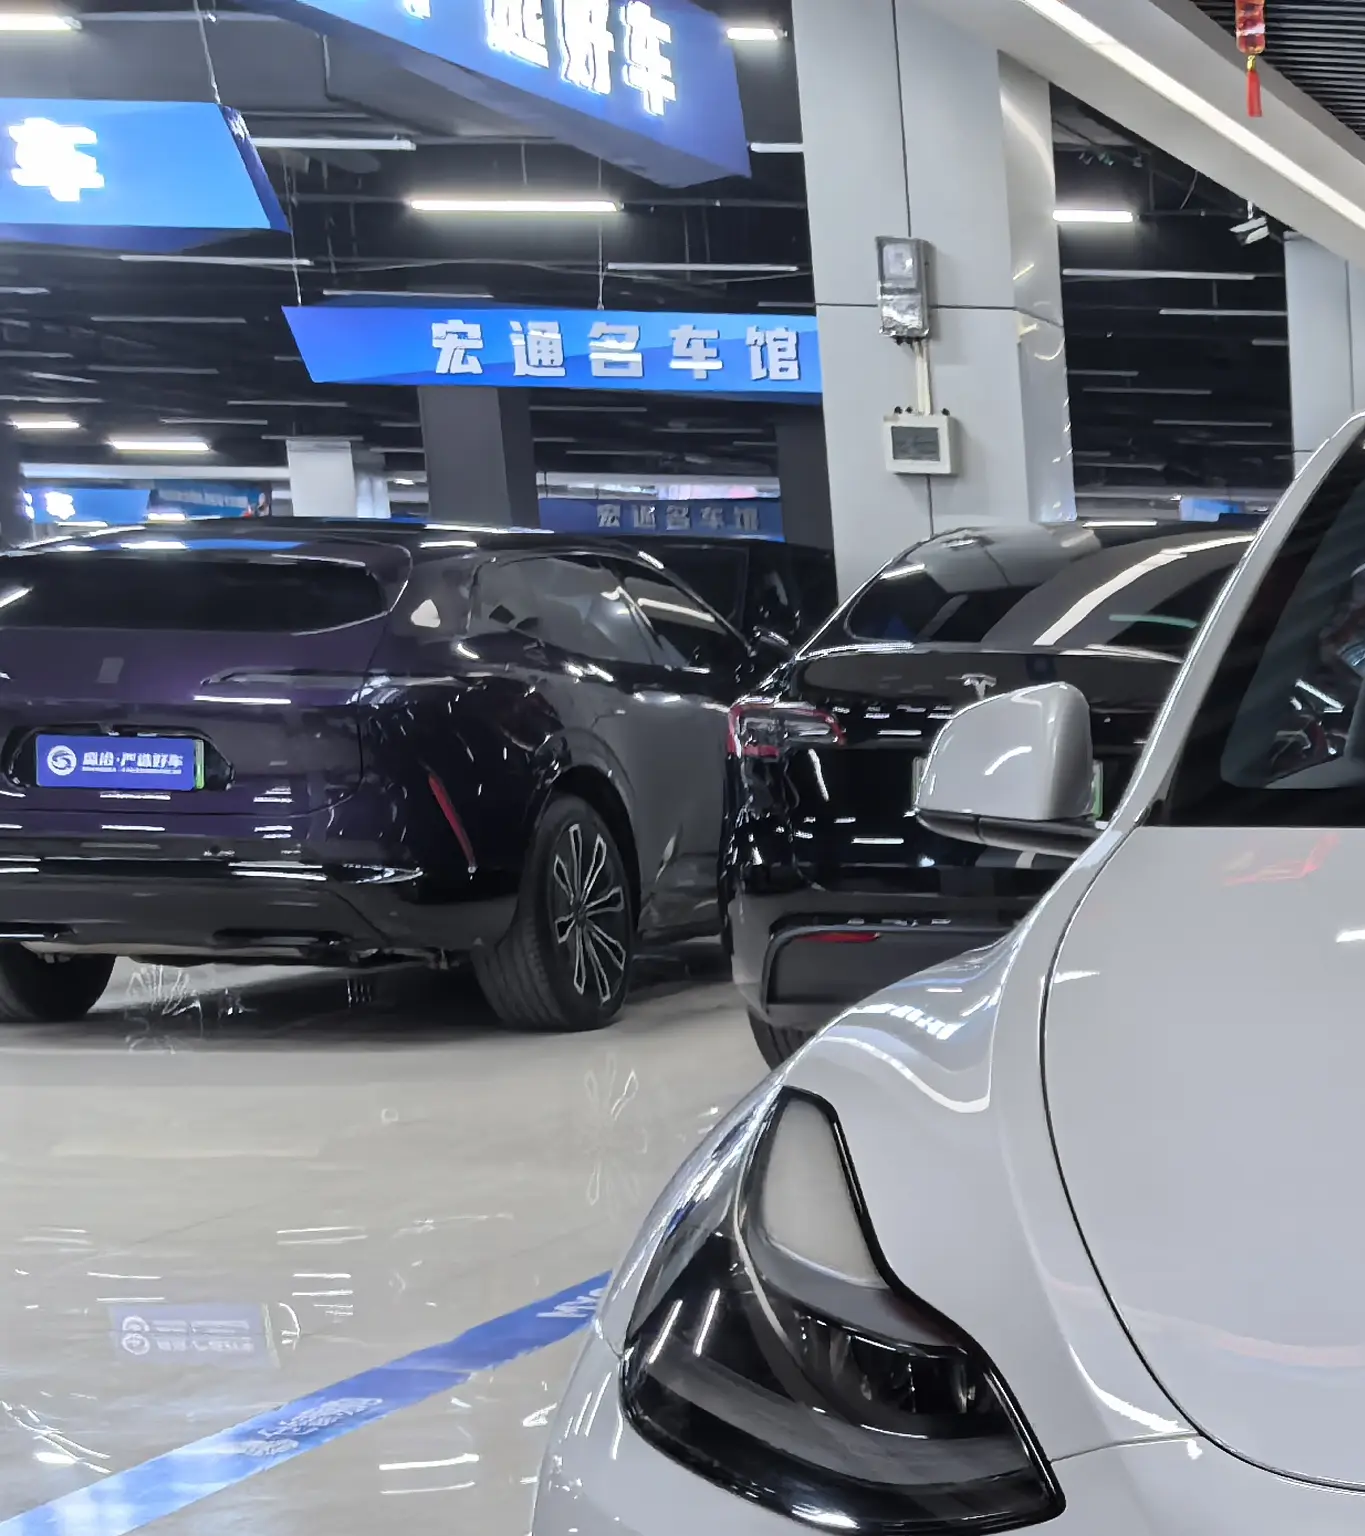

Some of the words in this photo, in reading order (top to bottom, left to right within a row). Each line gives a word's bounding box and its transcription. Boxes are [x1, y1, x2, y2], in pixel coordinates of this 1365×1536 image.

[431, 319, 800, 381] 宏通名车馆
